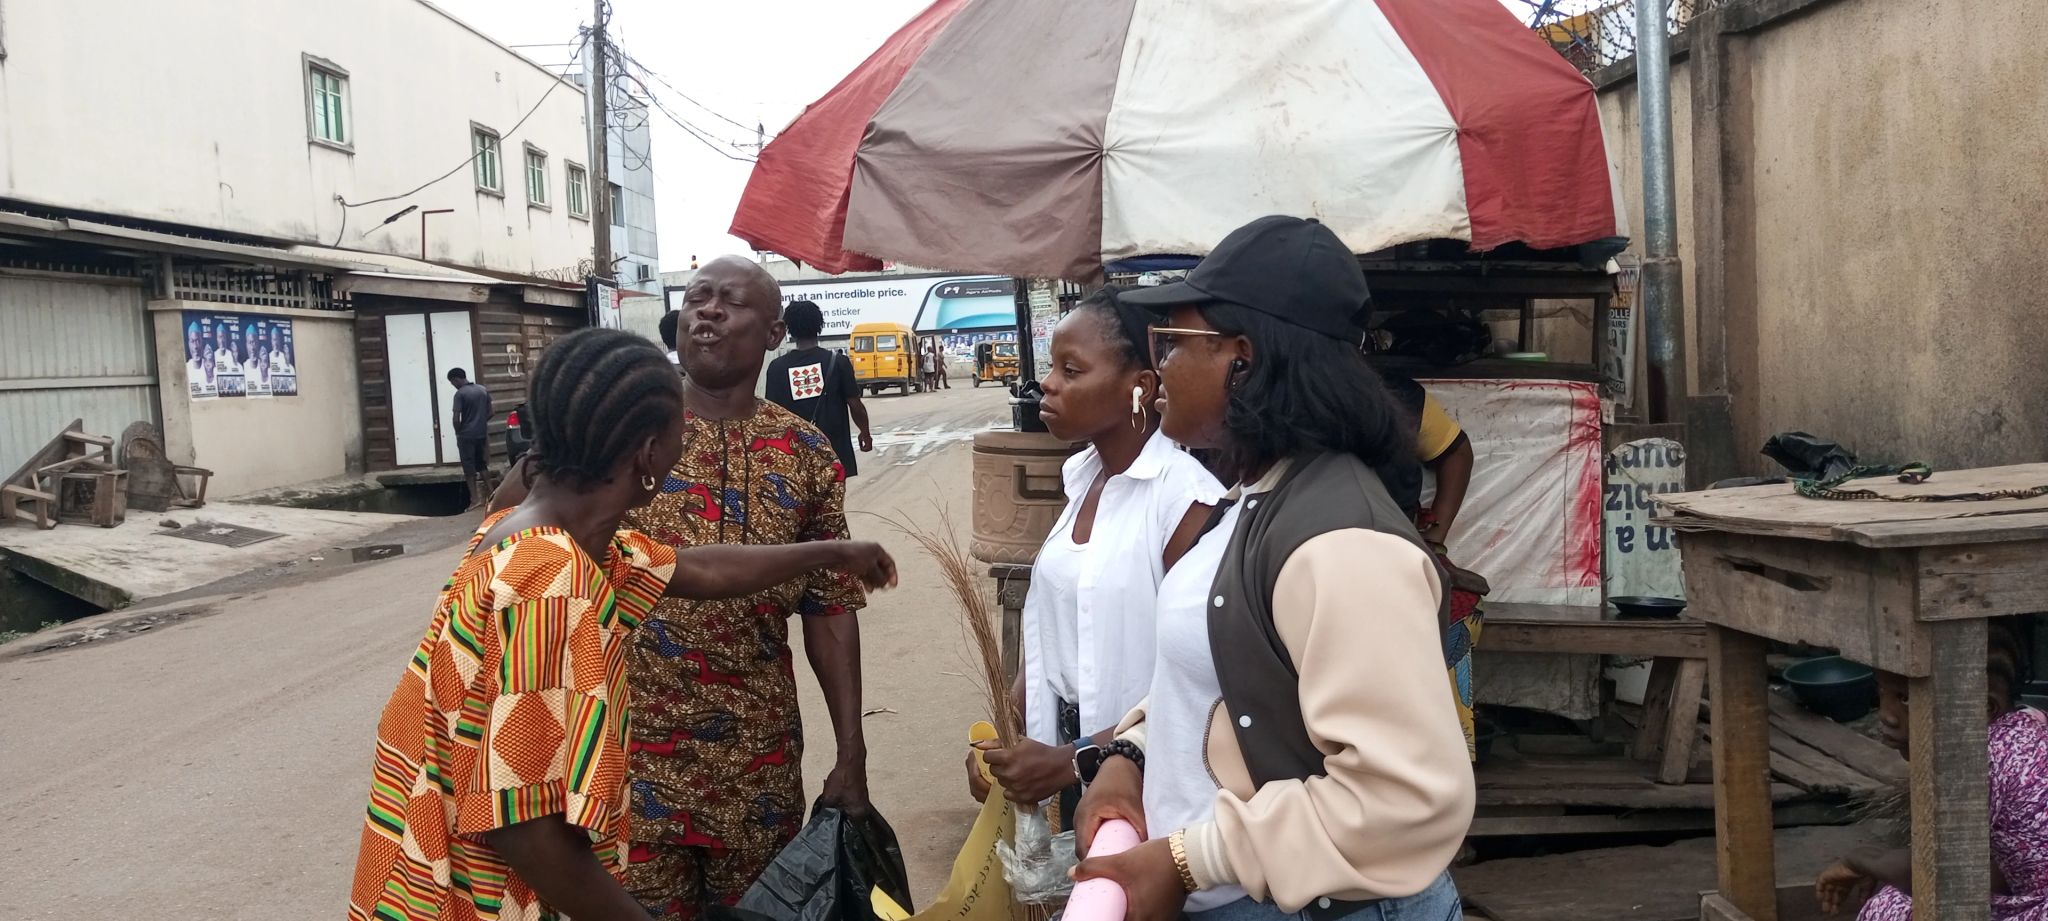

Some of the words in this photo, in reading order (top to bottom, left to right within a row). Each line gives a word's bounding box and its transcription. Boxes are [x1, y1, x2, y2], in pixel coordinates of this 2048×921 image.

[798, 292, 807, 301] at
[810, 292, 823, 300] an
[825, 288, 875, 299] incredible
[878, 287, 907, 299] price.
[832, 307, 860, 316] sticker
[1615, 525, 1635, 554] a
